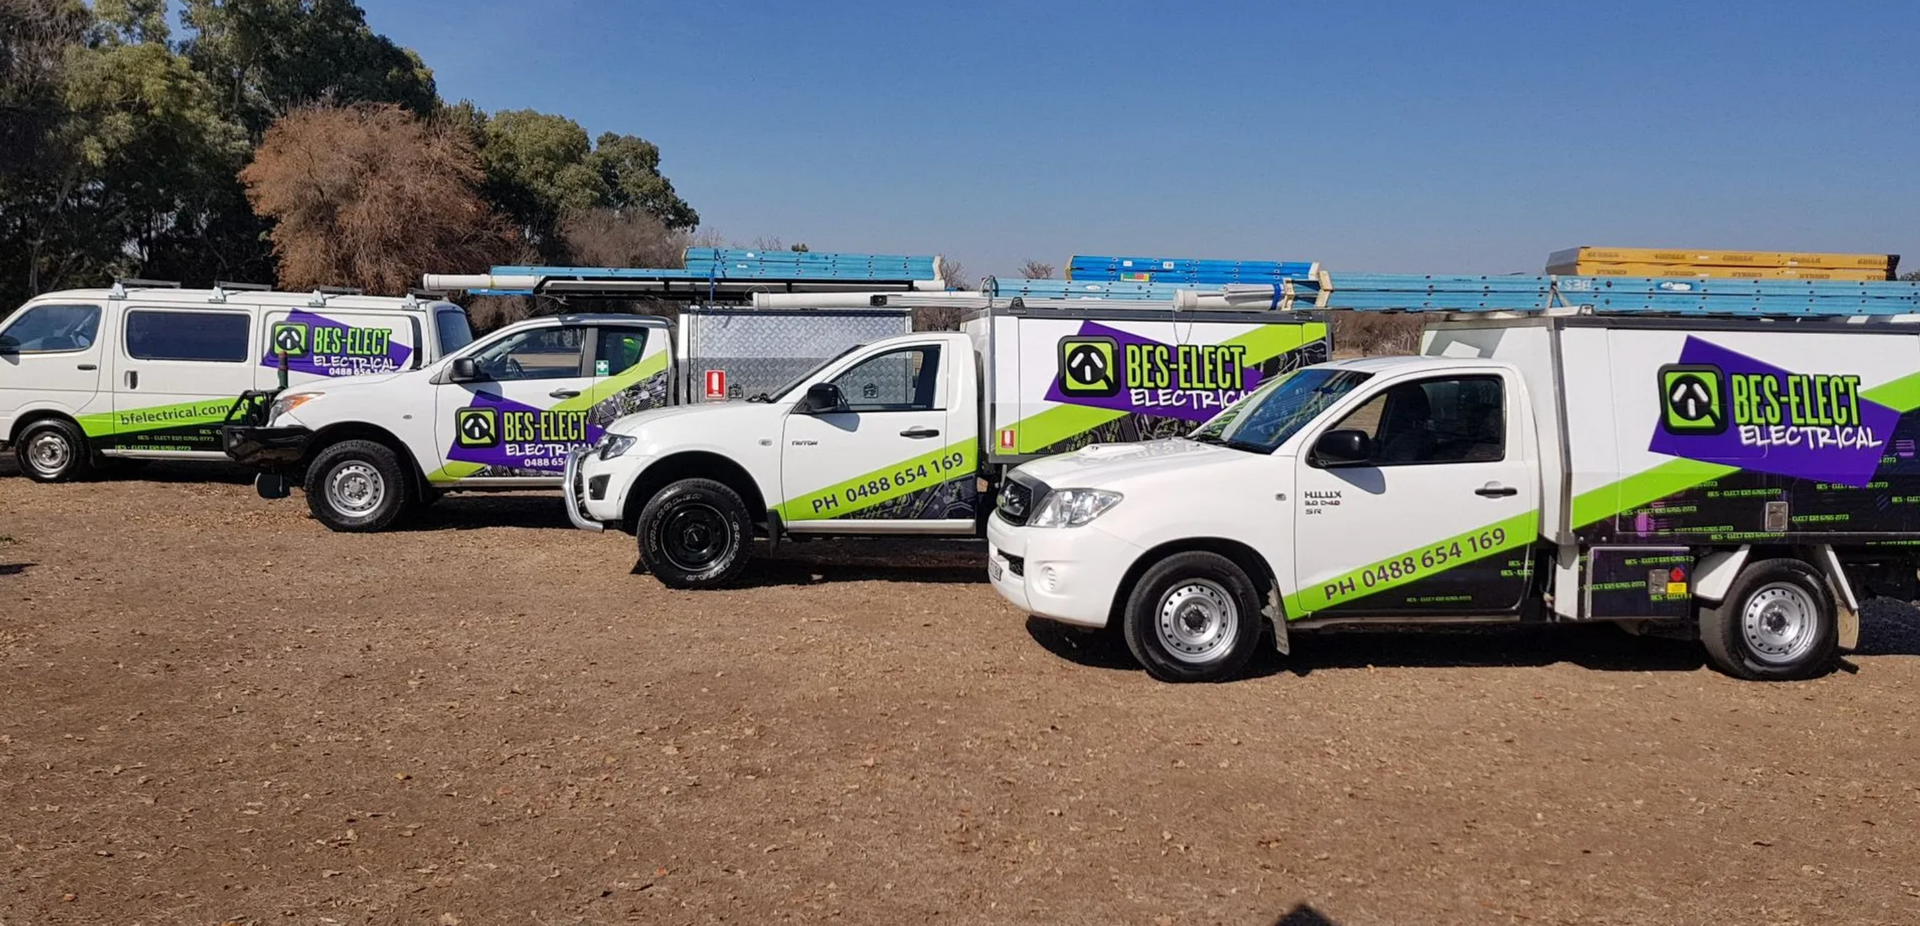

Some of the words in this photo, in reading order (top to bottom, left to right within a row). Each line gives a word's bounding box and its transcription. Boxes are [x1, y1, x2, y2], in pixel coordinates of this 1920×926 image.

[314, 327, 392, 356] BES-ELECT
[313, 356, 398, 370] ELECTRICAL
[329, 368, 352, 376] 0488
[1126, 344, 1244, 389] BES-ELECT
[1731, 374, 1860, 426] BES-ELECT
[504, 412, 588, 441] BES-ELECT
[1739, 425, 1883, 450] ELECTRICAL
[524, 458, 550, 466] 0488
[812, 494, 840, 514] PH
[845, 477, 890, 502] 0488
[894, 464, 928, 486] 654
[931, 452, 963, 474] 169
[1304, 490, 1342, 498] HILUX
[1324, 578, 1356, 600] PH
[1362, 557, 1416, 588] 0488
[1421, 542, 1462, 568] 654
[1467, 528, 1506, 553] 169
